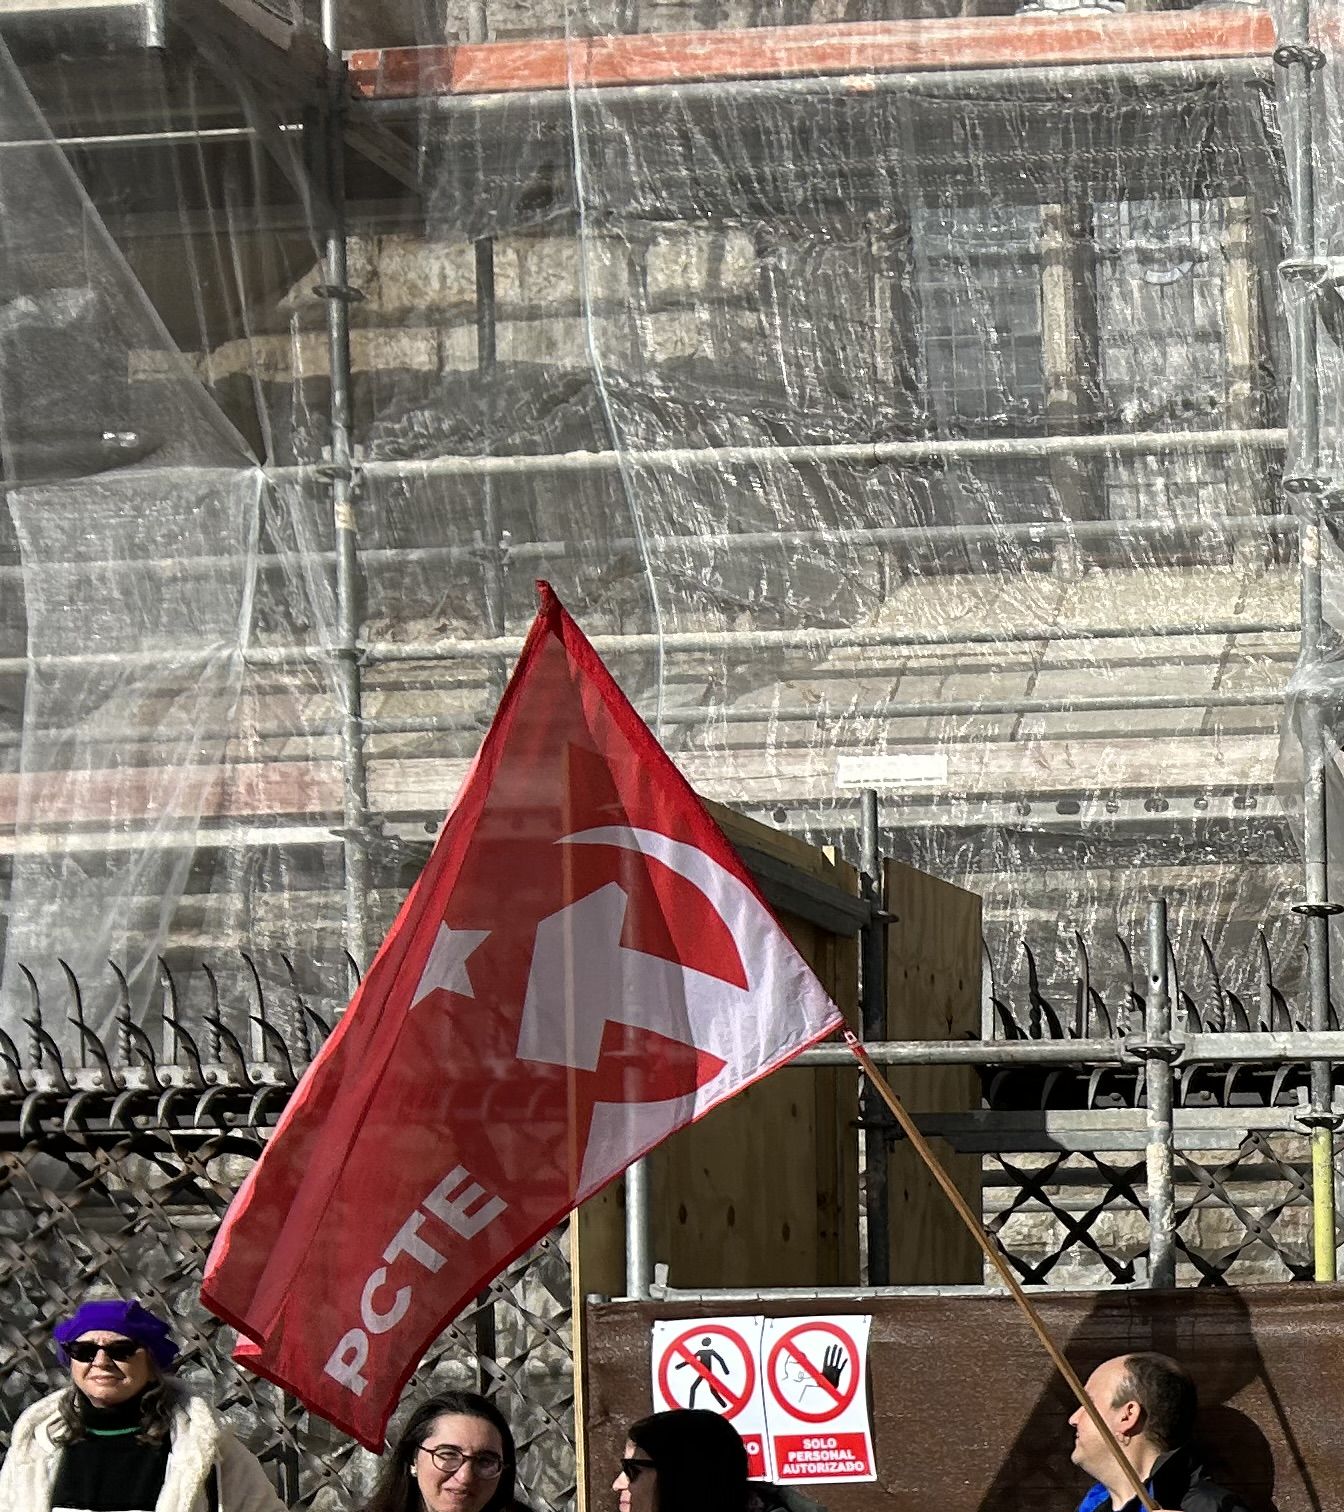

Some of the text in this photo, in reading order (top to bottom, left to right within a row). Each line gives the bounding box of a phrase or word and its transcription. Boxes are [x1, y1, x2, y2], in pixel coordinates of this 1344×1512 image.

[323, 1164, 508, 1398] PCTE
[803, 1438, 837, 1449] SOLO
[788, 1450, 855, 1463] PERSONAL
[783, 1461, 865, 1474] AUTORIZADO
